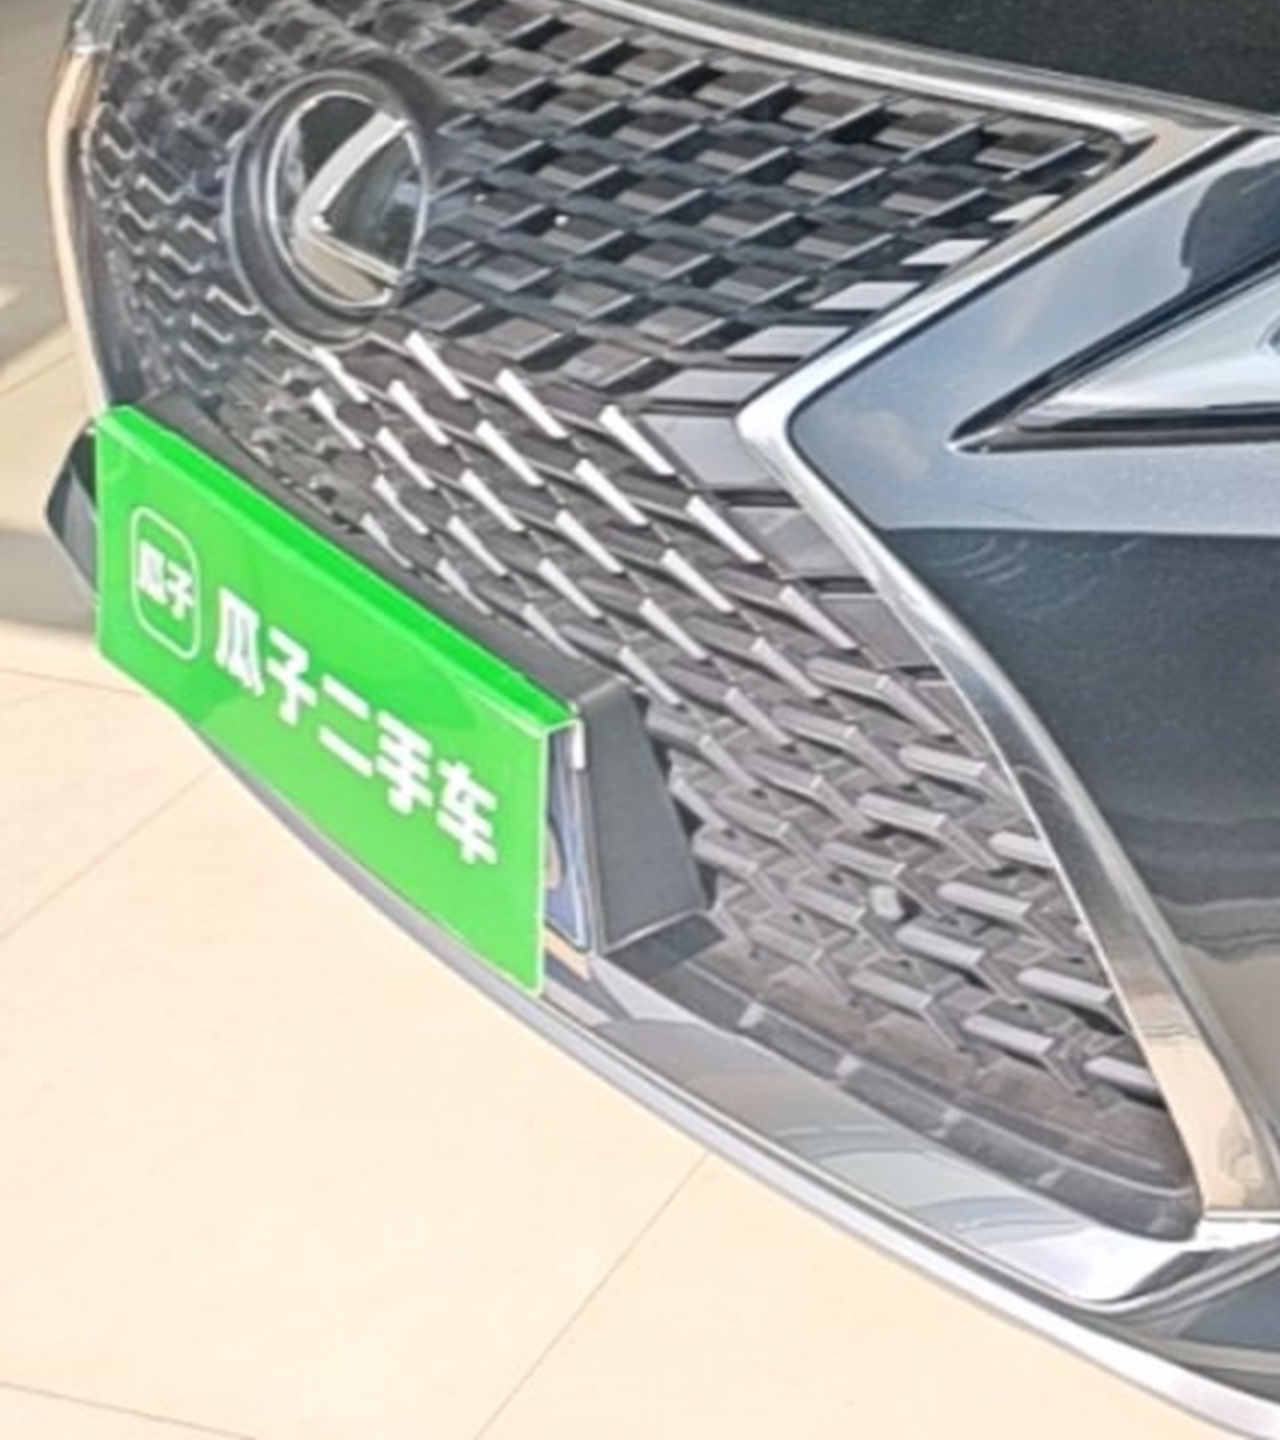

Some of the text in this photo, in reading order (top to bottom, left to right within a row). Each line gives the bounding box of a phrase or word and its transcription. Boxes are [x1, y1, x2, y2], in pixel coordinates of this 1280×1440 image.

[137, 541, 193, 619] 瓜子
[215, 588, 497, 863] 瓜子二手车
